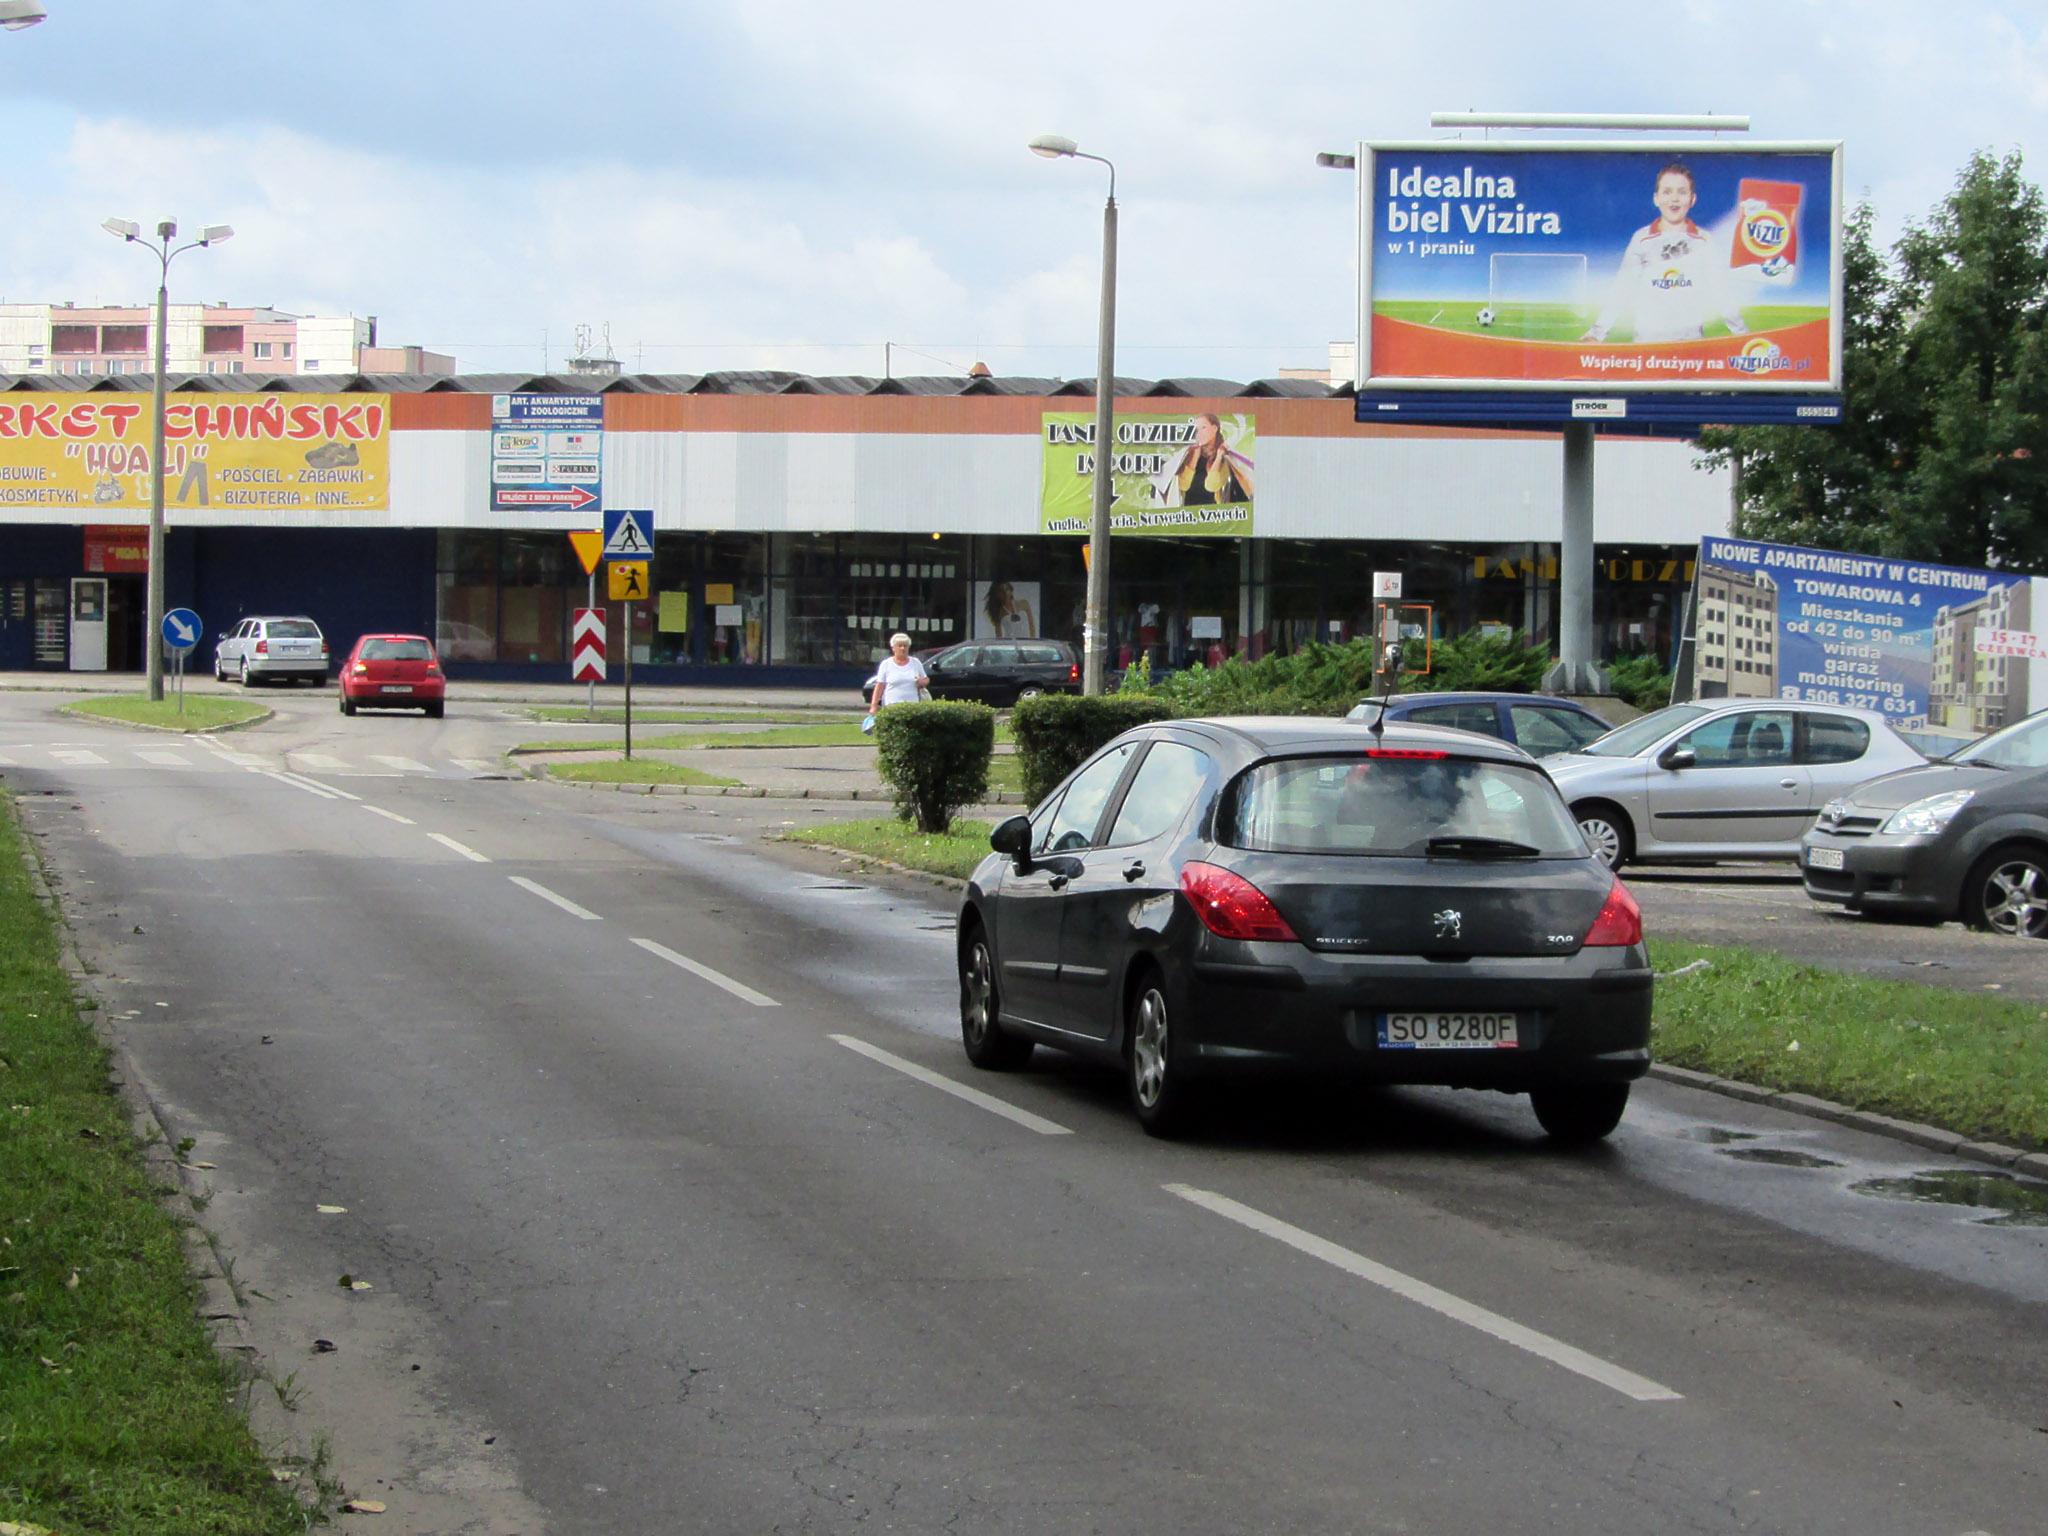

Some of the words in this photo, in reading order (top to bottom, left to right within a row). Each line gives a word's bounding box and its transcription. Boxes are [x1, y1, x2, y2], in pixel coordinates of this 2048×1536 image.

[1389, 166, 1515, 199] Idealna
[1388, 203, 1449, 234] biel
[1461, 204, 1561, 235] Vizira
[1388, 243, 1404, 255] w
[1408, 242, 1415, 255] 1
[1421, 241, 1475, 258] praniu
[1580, 355, 1643, 373] Wspieraj
[1645, 354, 1704, 373] drużyny
[1706, 357, 1725, 369] na
[530, 397, 602, 406] AKWARYSTYCZNE
[530, 407, 589, 416] ZOOLOGICZNE
[165, 396, 383, 440] CHIŃSKI
[1046, 423, 1113, 444] TANI
[1117, 416, 1197, 444] ODZIEŻ
[0, 467, 48, 481] BUWIE
[297, 469, 365, 483] ZABAWKI
[225, 487, 302, 505] BIŻUTERIA
[1198, 506, 1248, 524] Szwecja
[1710, 543, 1761, 565] NOWE
[1764, 556, 1885, 580] APARTAMENTY
[1889, 565, 1905, 581] W
[1907, 566, 1988, 592] CENTRUM
[1793, 578, 1905, 606] TOWAROWA
[1908, 592, 1922, 608] 4
[1801, 602, 1904, 628] Mieszkania
[1786, 619, 1810, 634] od
[1814, 621, 1838, 637] 42
[1842, 625, 1866, 641] do
[1871, 627, 1894, 643] 90
[1823, 642, 1882, 660] winda
[1824, 659, 1879, 677] garaż
[1798, 670, 1905, 698] monitoring
[1805, 688, 1841, 705] 506
[1844, 693, 1878, 709] 327
[1883, 698, 1918, 715] 631
[1886, 715, 1925, 730] se.pl
[1391, 1015, 1428, 1041] SO
[1437, 1015, 1513, 1041] 8280F
